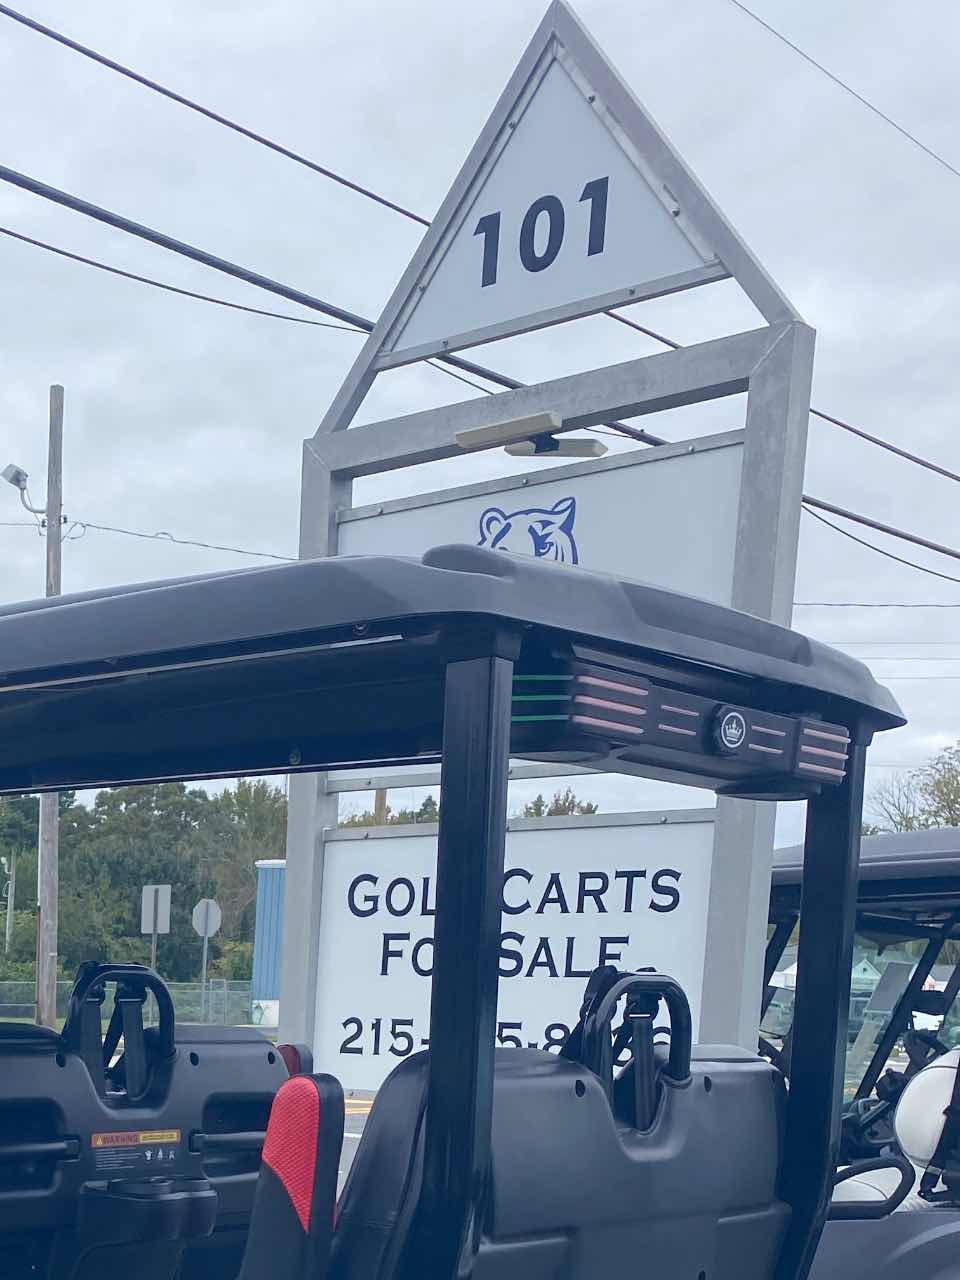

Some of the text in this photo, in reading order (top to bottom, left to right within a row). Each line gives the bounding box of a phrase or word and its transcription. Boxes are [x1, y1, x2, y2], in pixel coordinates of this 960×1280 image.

[473, 176, 609, 288] 101
[347, 868, 682, 917] GOL CARTS
[380, 931, 630, 977] FO SALE
